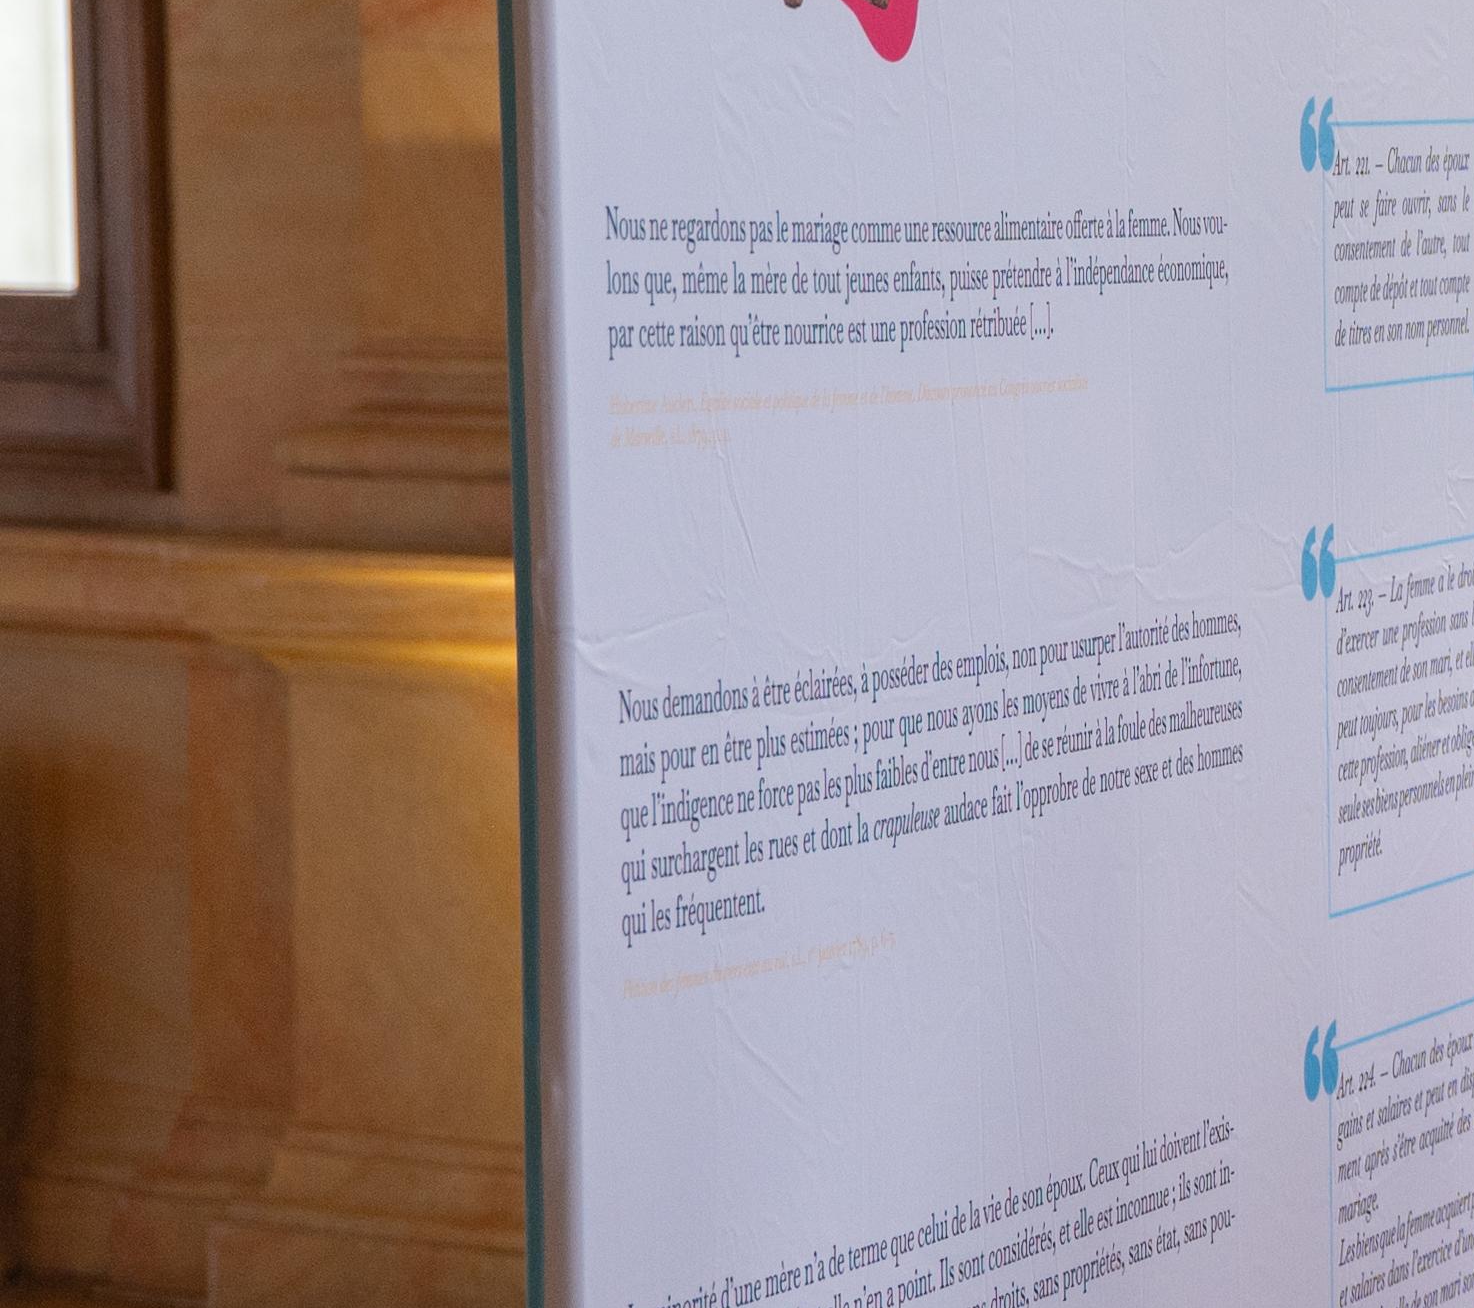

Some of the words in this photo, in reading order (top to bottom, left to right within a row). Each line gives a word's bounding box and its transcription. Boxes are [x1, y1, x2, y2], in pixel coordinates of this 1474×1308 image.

[1332, 150, 1350, 176] Art.
[1354, 156, 1370, 176] 221.
[1387, 146, 1422, 174] Chacun
[1425, 145, 1440, 171] des
[1442, 146, 1470, 180] époux
[604, 204, 646, 241] Nous
[648, 218, 668, 241] ne
[670, 207, 746, 253] regardons
[748, 220, 773, 254] pas
[775, 209, 788, 243] le
[791, 211, 848, 255] mariage
[850, 221, 901, 243] comme
[903, 221, 929, 243] une
[931, 221, 991, 242] ressource
[993, 210, 1063, 241] alimentaire
[1065, 208, 1104, 239] offerte
[1106, 208, 1113, 238] à
[1114, 208, 1126, 238] la
[1127, 208, 1170, 237] femme.
[1172, 206, 1201, 236] Nous
[1202, 215, 1228, 234] vou-
[1331, 198, 1354, 229] peut
[1359, 199, 1369, 218] se
[1372, 188, 1396, 226] faire
[1401, 189, 1431, 217] ouvrir,
[1436, 194, 1457, 212] sans
[1462, 185, 1470, 211] le
[605, 259, 639, 294] lons
[643, 271, 677, 306] que,
[681, 262, 728, 294] même
[731, 260, 746, 294] la
[750, 261, 787, 294] mère
[791, 260, 808, 294] de
[812, 269, 841, 293] tout
[844, 262, 889, 305] jeunes
[892, 260, 945, 298] enfants,
[949, 261, 988, 302] puisse
[991, 256, 1051, 300] prétendre
[1055, 257, 1063, 286] à
[1157, 252, 1228, 289] économique,
[607, 325, 634, 361] par
[638, 322, 675, 347] cette
[678, 314, 726, 347] raison
[783, 313, 844, 345] nourrice
[847, 320, 867, 343] est
[870, 321, 896, 343] une
[899, 308, 967, 353] profession
[969, 306, 1026, 338] rétribuée
[1334, 318, 1346, 346] de
[1348, 320, 1372, 345] titres
[1373, 324, 1384, 343] en
[1386, 323, 1402, 341] son
[1404, 321, 1424, 339] nom
[1425, 307, 1469, 347] personnel.
[618, 688, 659, 724] Nous
[661, 678, 748, 719] demandons
[751, 675, 760, 708] à
[762, 674, 790, 707] être
[793, 665, 857, 703] éclairées,
[860, 662, 869, 694] à
[871, 653, 929, 703] posséder
[931, 649, 953, 681] des
[955, 643, 1009, 687] emplois,
[1011, 646, 1037, 670] non
[1038, 641, 1068, 676] pour
[1070, 633, 1116, 666] usurper
[1171, 612, 1189, 642] des
[1191, 609, 1241, 639] hommes,
[1337, 829, 1382, 876] propriété.
[621, 901, 647, 948] qui
[650, 898, 671, 932] les
[675, 888, 765, 935] fréquentent.
[764, 1260, 801, 1298] mère
[828, 1244, 845, 1277] de
[847, 1238, 887, 1271] terme
[890, 1230, 914, 1268] que
[917, 1209, 949, 1248] celui
[950, 1204, 966, 1236] de
[968, 1199, 981, 1230] la
[982, 1193, 1002, 1224] vie
[1003, 1185, 1019, 1218] de
[1021, 1185, 1044, 1212] son
[1045, 1172, 1086, 1212] époux.
[1088, 1156, 1120, 1188] Ceux
[1121, 1144, 1140, 1186] qui
[1141, 1138, 1158, 1170] lui
[1159, 1129, 1201, 1163] doivent
